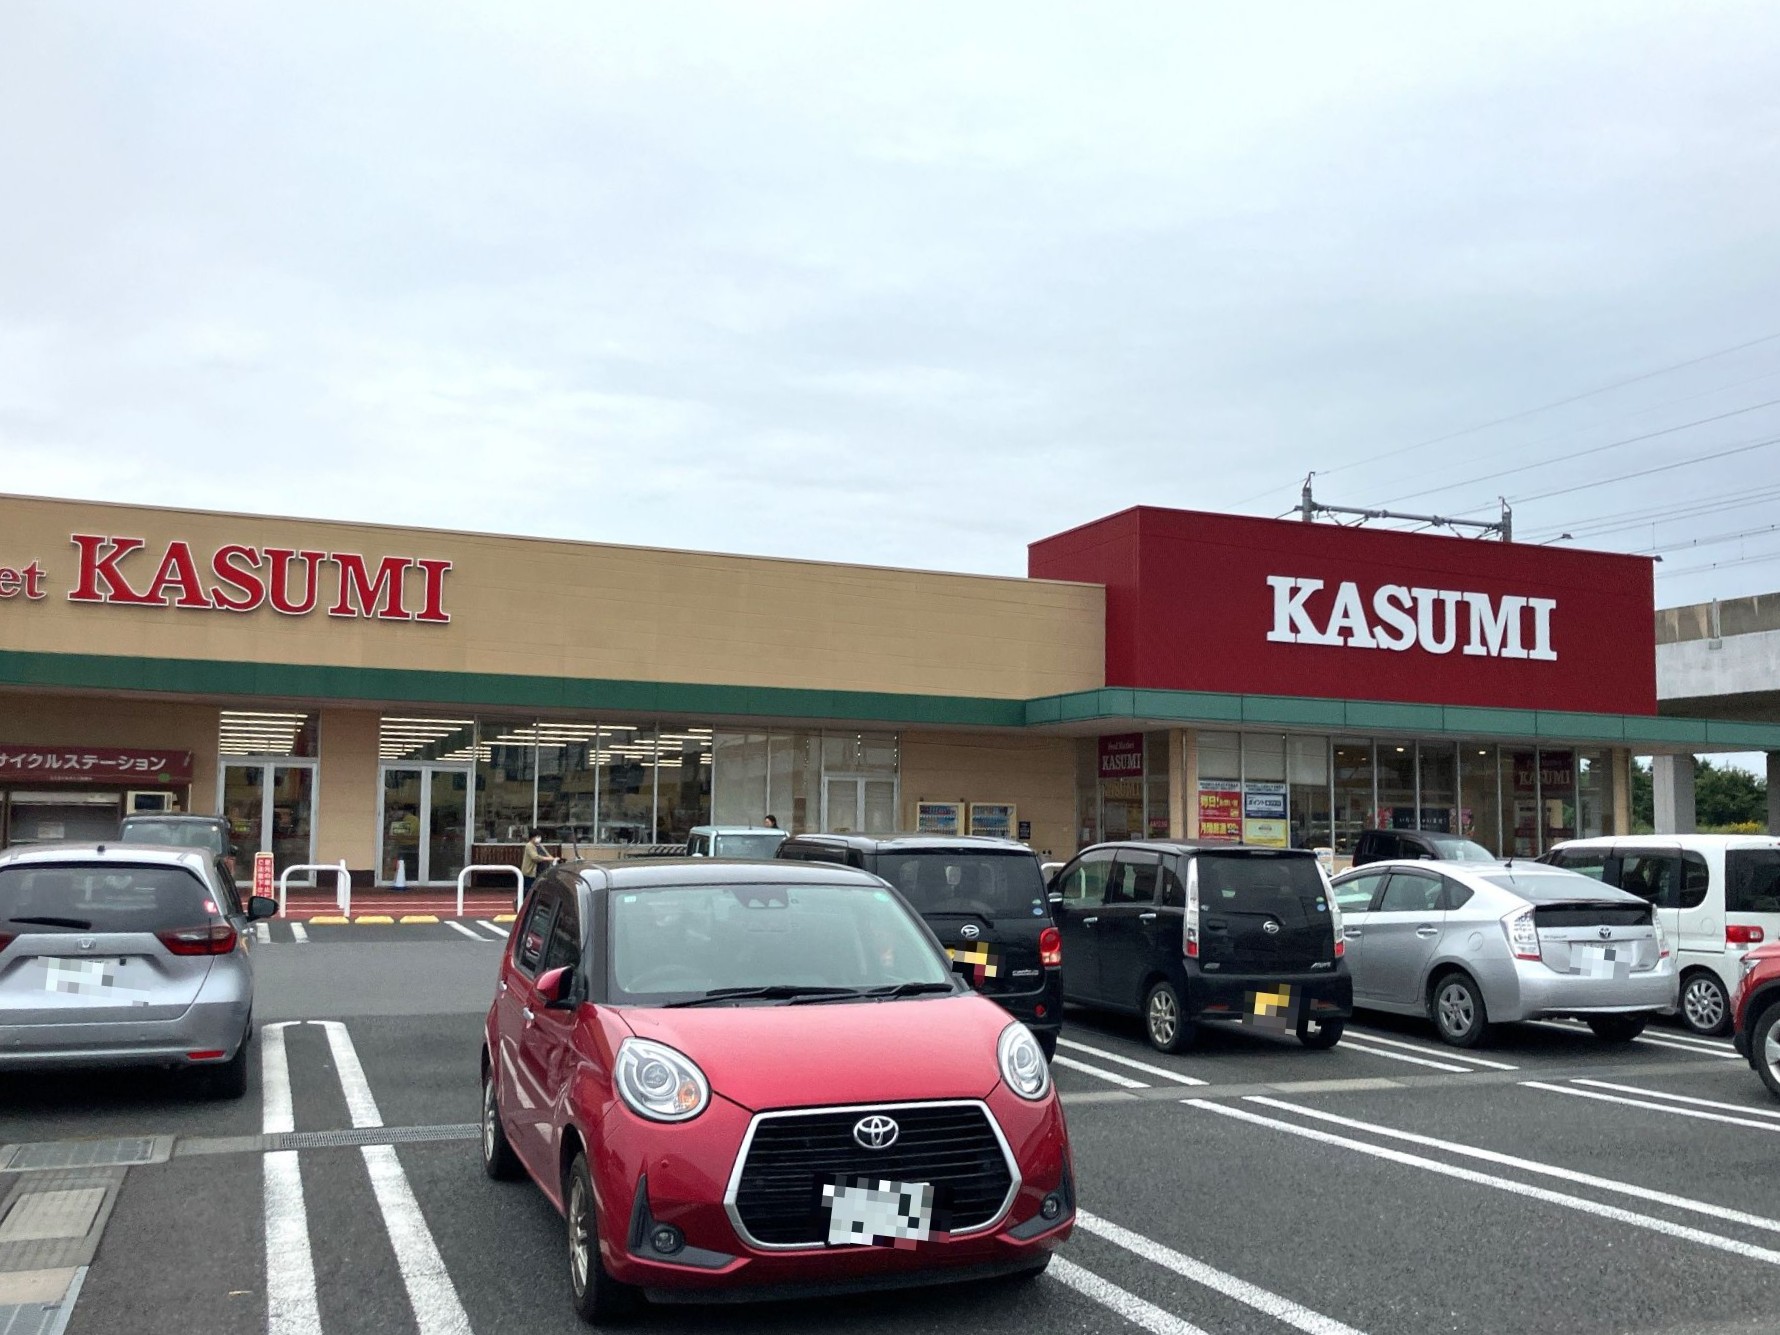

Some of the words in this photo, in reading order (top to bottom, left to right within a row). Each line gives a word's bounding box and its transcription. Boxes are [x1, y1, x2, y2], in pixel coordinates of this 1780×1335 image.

[67, 533, 453, 623] KASUMI
[1266, 575, 1557, 661] KASUMI
[1102, 753, 1142, 770] KASUMI
